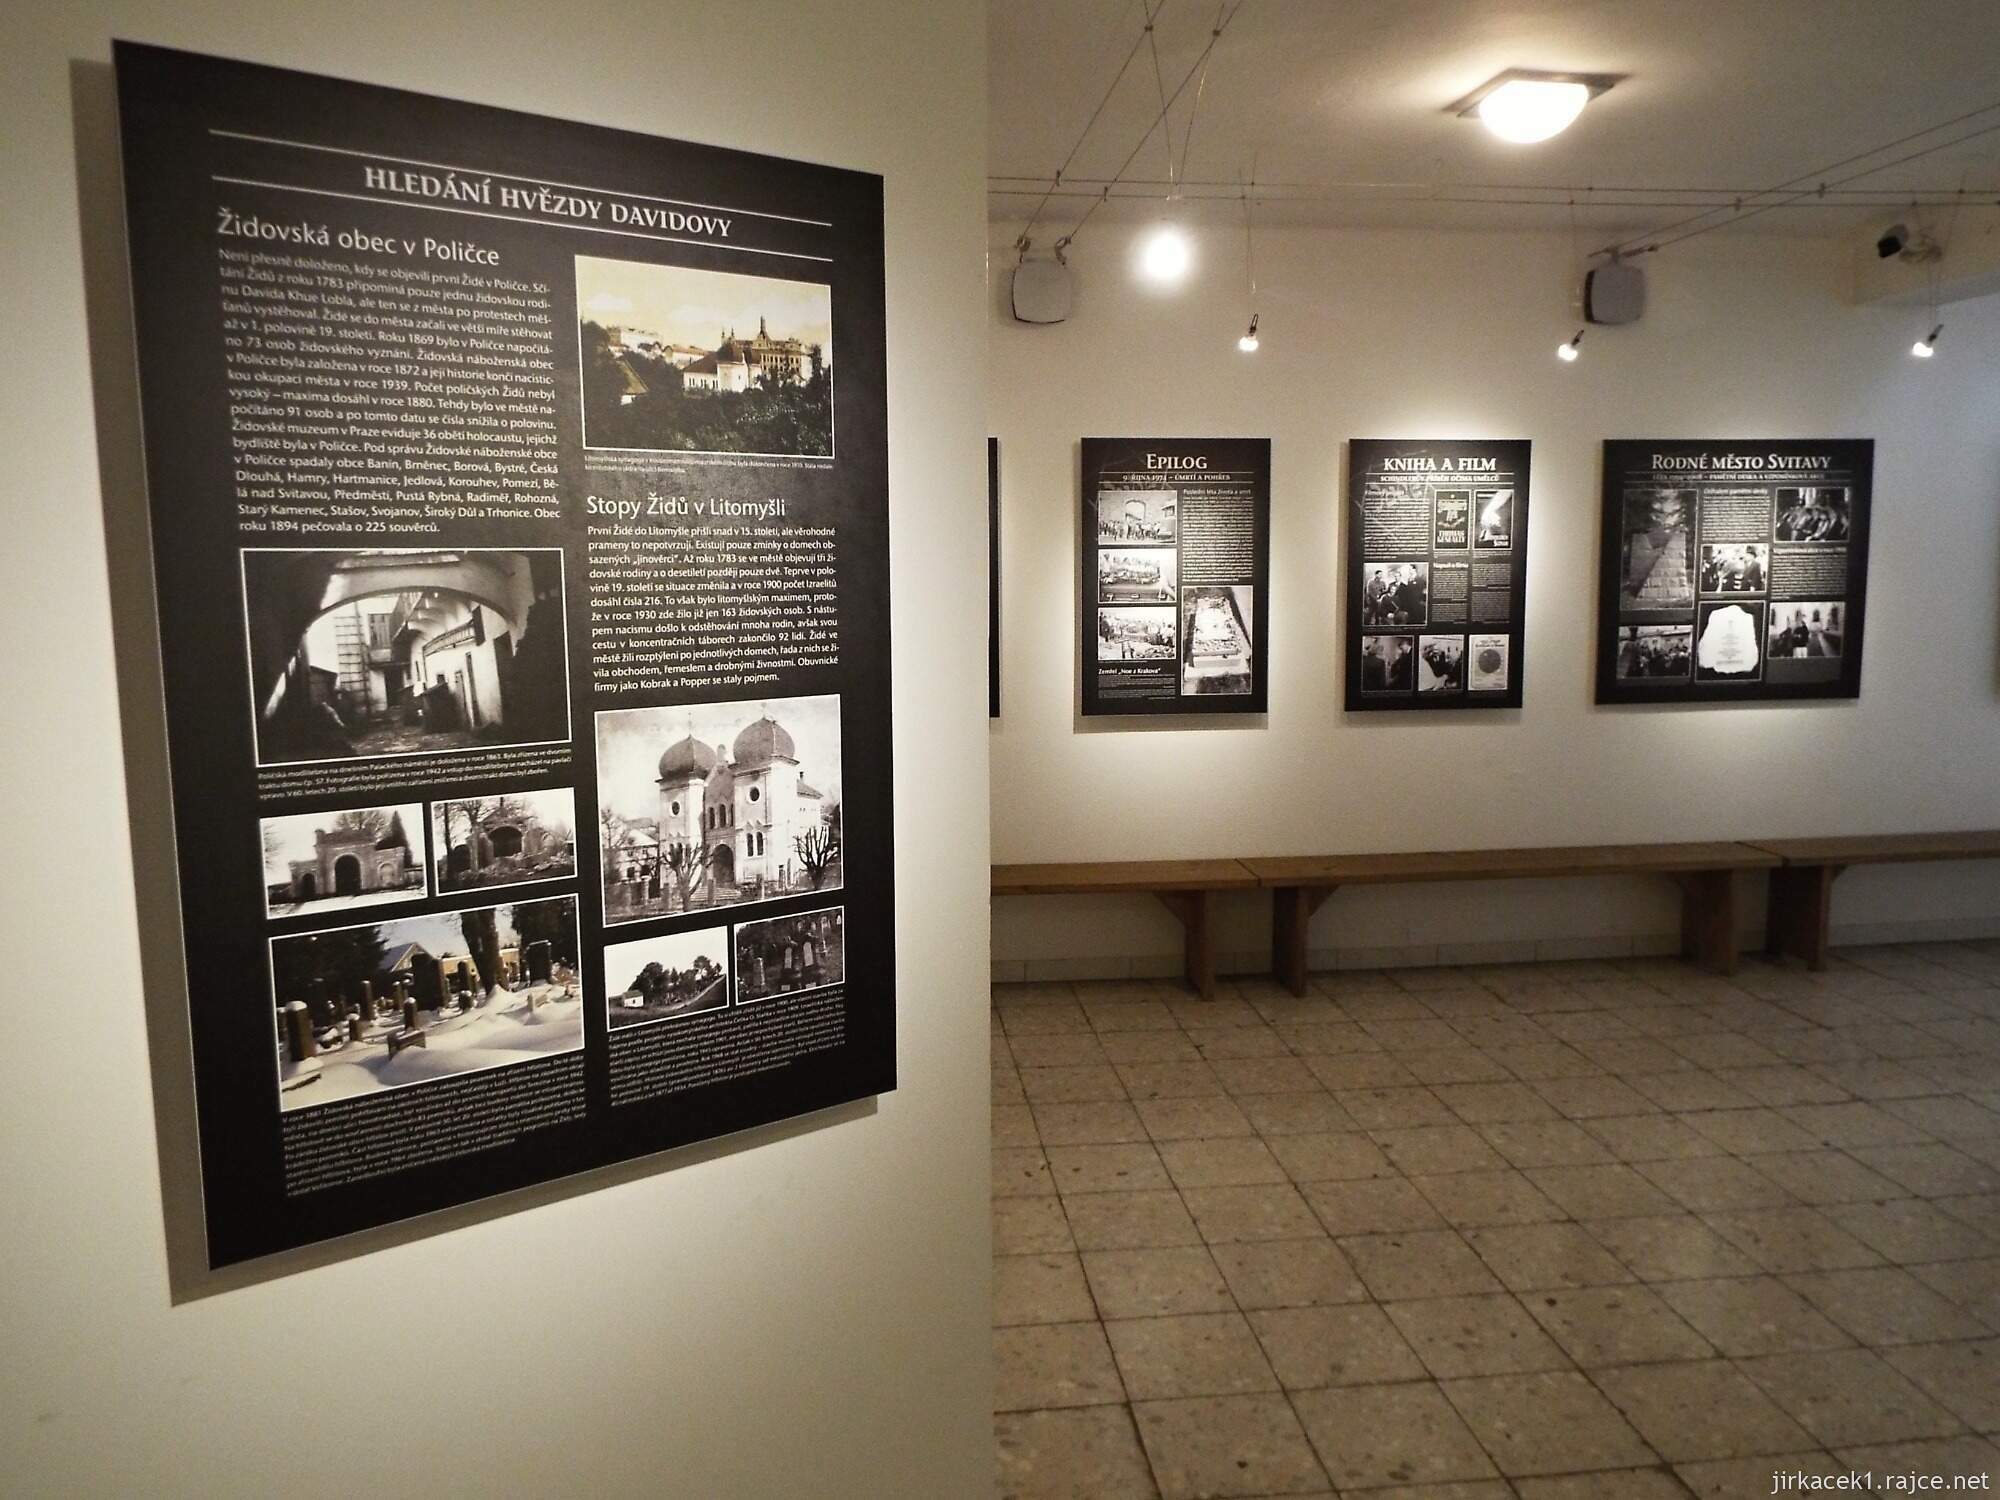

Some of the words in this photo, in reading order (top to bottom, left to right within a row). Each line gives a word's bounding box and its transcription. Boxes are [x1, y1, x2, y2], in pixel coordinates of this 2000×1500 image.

[365, 167, 491, 204] HLEDÁNÍ
[500, 187, 602, 219] HVĚZDY
[610, 203, 733, 236] DAVIDOVY
[217, 207, 330, 246] Židovská
[338, 229, 397, 254] obec
[403, 240, 416, 255] v
[423, 238, 499, 266] Poličce
[233, 455, 241, 464] v
[1383, 457, 1437, 471] KNIHA
[1440, 457, 1454, 471] A
[1458, 457, 1497, 471] FILM
[1652, 453, 1708, 470] RODNÉ
[1712, 453, 1764, 470] MĚSTO
[236, 485, 248, 498] lá
[477, 508, 484, 516] a
[586, 496, 641, 519] Stopy
[646, 492, 689, 515] Židů
[694, 502, 704, 515] v
[710, 497, 786, 520] Litomyšli
[354, 522, 363, 531] o
[612, 521, 632, 535] Židé
[634, 524, 646, 535] do
[690, 525, 711, 538] přišli
[712, 525, 732, 535] snad
[740, 525, 752, 535] 15.
[781, 525, 793, 535] ale
[587, 541, 629, 551] prameny
[630, 539, 640, 549] to
[725, 541, 751, 551] pouze
[789, 538, 821, 548] domech
[822, 538, 835, 548] ob-
[682, 552, 694, 562] Až
[695, 552, 714, 562] roku
[717, 552, 736, 562] 1783
[748, 554, 758, 562] ve
[759, 552, 783, 562] městě
[826, 552, 836, 561] ži-
[588, 567, 621, 578] dovské
[622, 566, 651, 579] rodiny
[652, 569, 658, 577] a
[659, 569, 666, 577] o
[706, 565, 738, 578] později
[738, 568, 763, 578] pouze
[765, 565, 782, 575] dvě.
[783, 565, 809, 577] Teprve
[816, 564, 836, 577] polo-
[589, 581, 609, 592] vině
[611, 581, 625, 592] 19.
[654, 583, 664, 591] se
[665, 580, 695, 591] situace
[696, 579, 729, 590] změnila
[743, 581, 761, 589] roce
[763, 578, 782, 589] 1900
[782, 578, 804, 590] počet
[589, 595, 621, 606] dosáhl
[644, 594, 662, 605] 216.
[664, 594, 675, 604] To
[676, 593, 695, 604] však
[696, 593, 715, 606] bylo
[813, 591, 837, 603] proto-
[590, 610, 601, 620] že
[603, 612, 609, 620] v
[611, 611, 631, 620] roce
[635, 608, 656, 619] 1930
[658, 607, 673, 618] zde
[676, 607, 691, 618] žilo
[693, 607, 703, 620] již
[705, 607, 719, 619] jen
[722, 606, 736, 616] 163
[783, 604, 805, 614] osob.
[806, 603, 811, 613] S
[813, 603, 836, 613] nástu-
